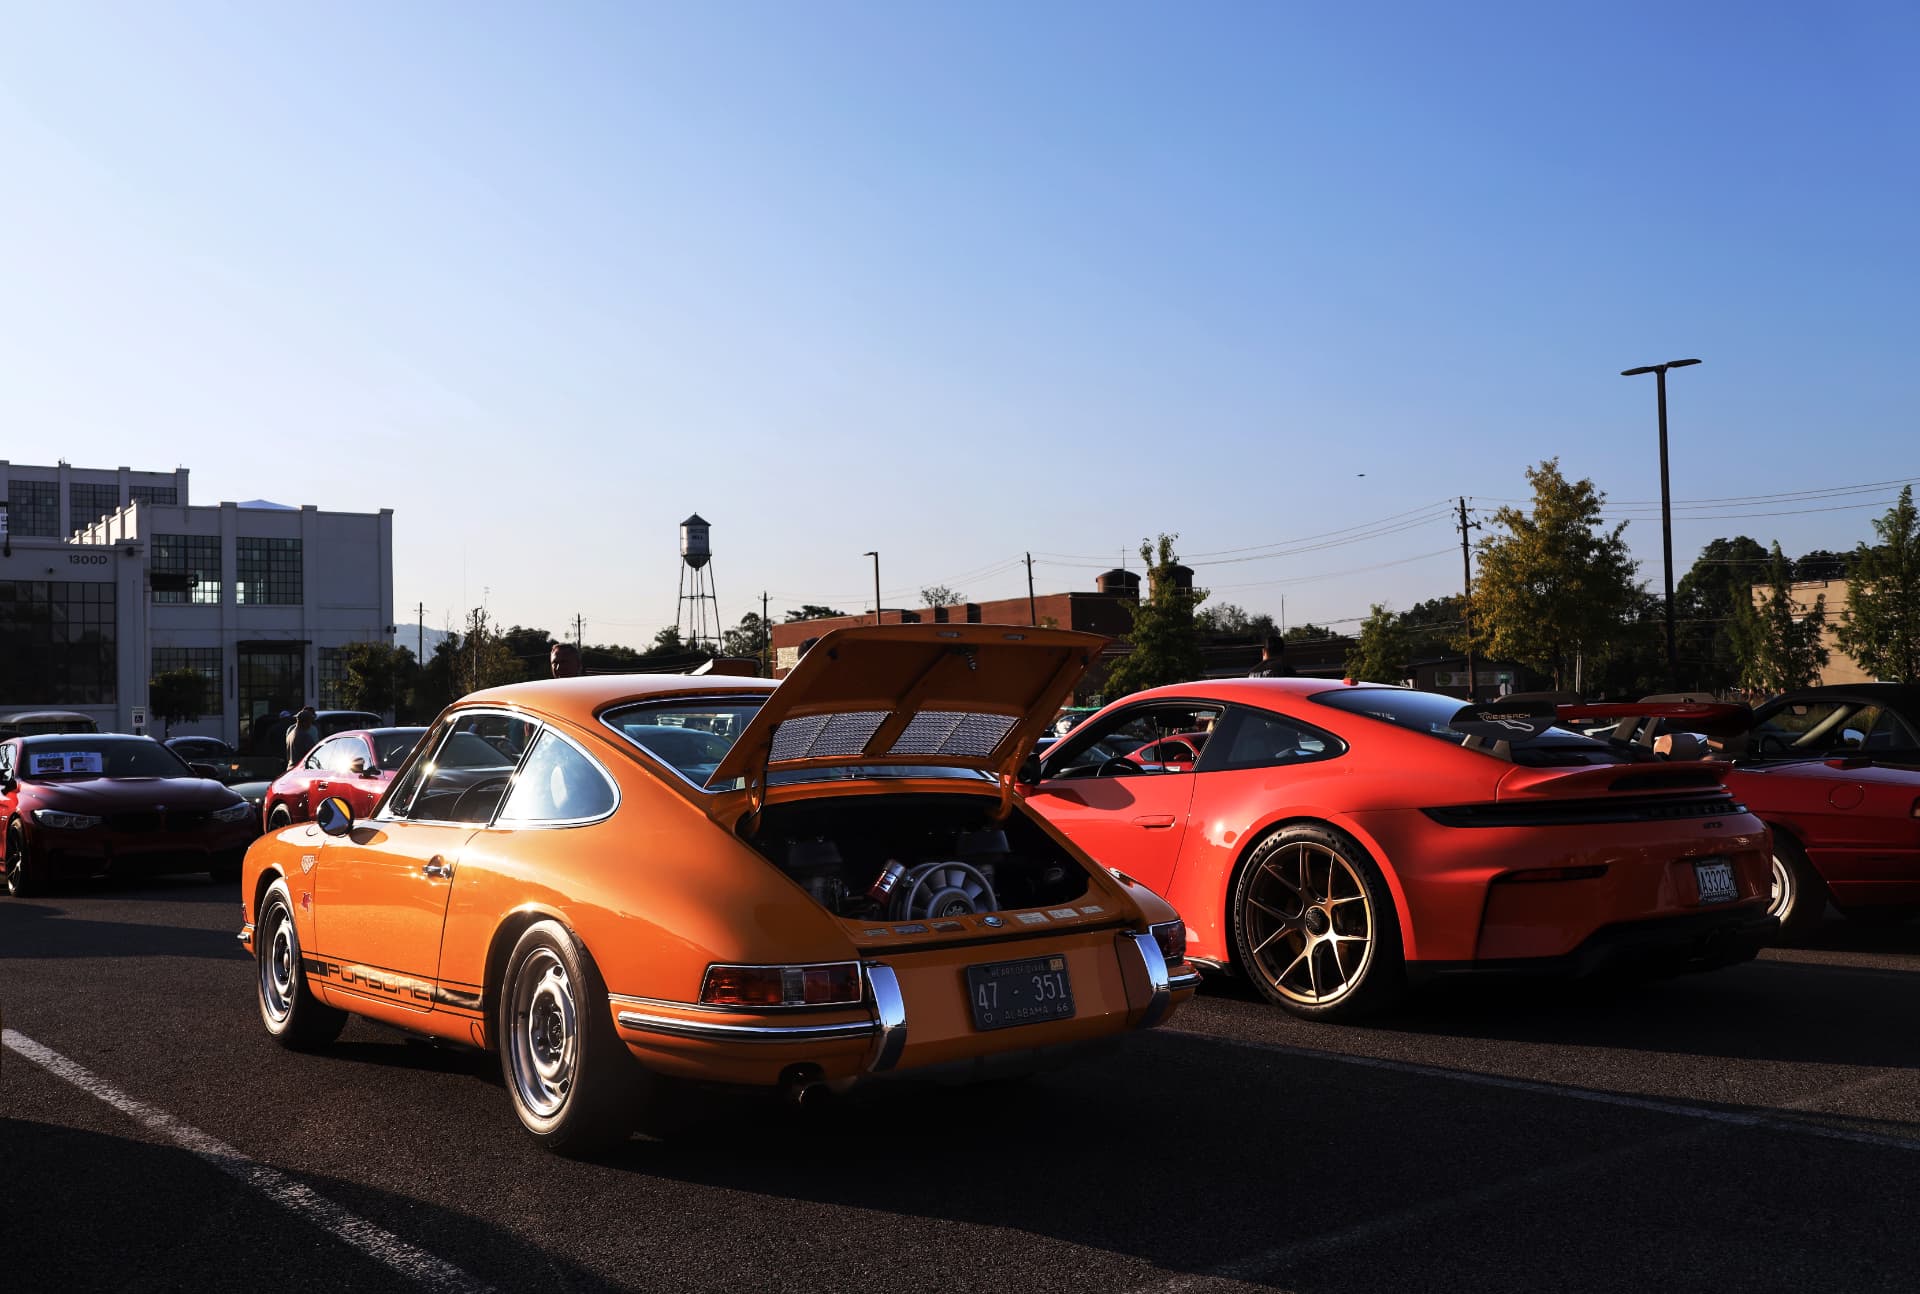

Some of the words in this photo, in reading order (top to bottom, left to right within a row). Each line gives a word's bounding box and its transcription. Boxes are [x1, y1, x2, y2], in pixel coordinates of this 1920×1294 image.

[69, 554, 108, 565] 1300D
[978, 982, 998, 1009] 47
[1032, 973, 1066, 1001] 351
[1005, 1005, 1049, 1019] ALABAMA
